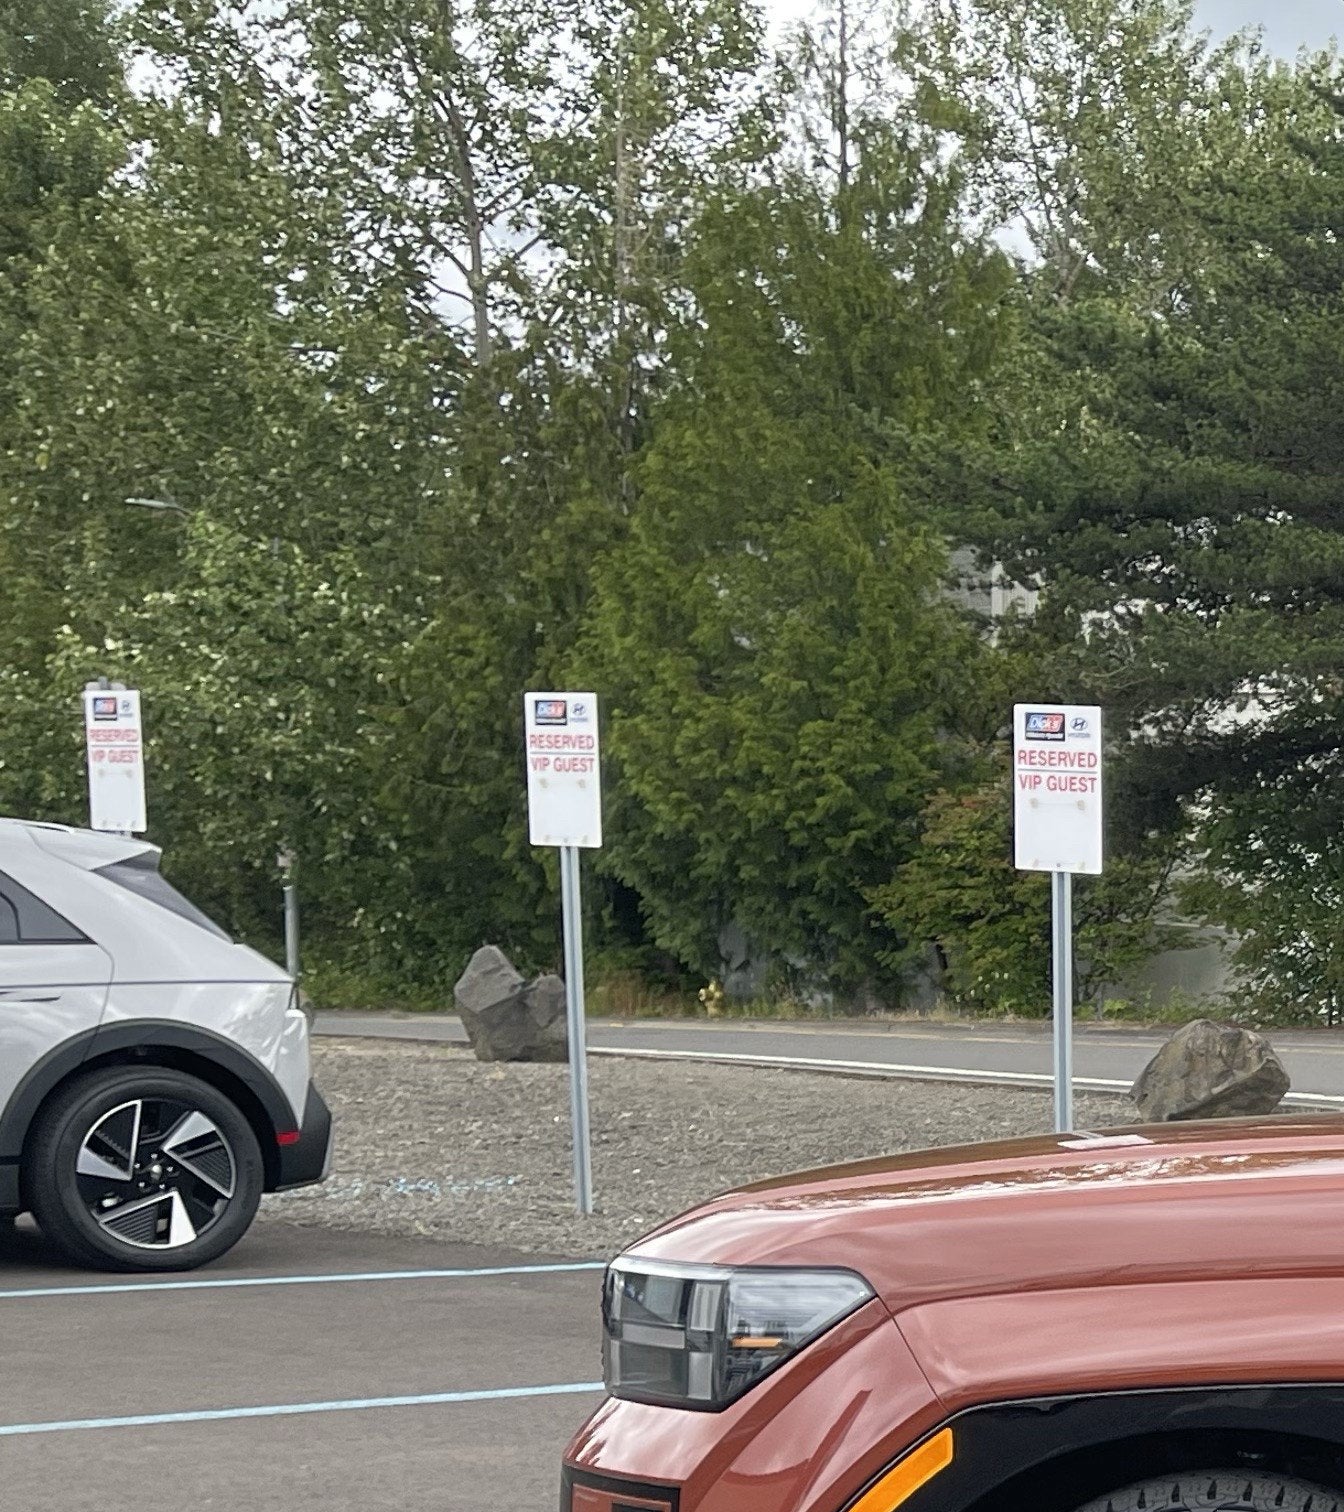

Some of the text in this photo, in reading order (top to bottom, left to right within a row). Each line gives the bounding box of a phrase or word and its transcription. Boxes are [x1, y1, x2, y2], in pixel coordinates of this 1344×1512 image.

[529, 734, 595, 750] RESERVED
[531, 757, 595, 772] VIP GUEST
[1017, 750, 1098, 768] RESERVED
[1018, 774, 1098, 793] VIP GUEST
